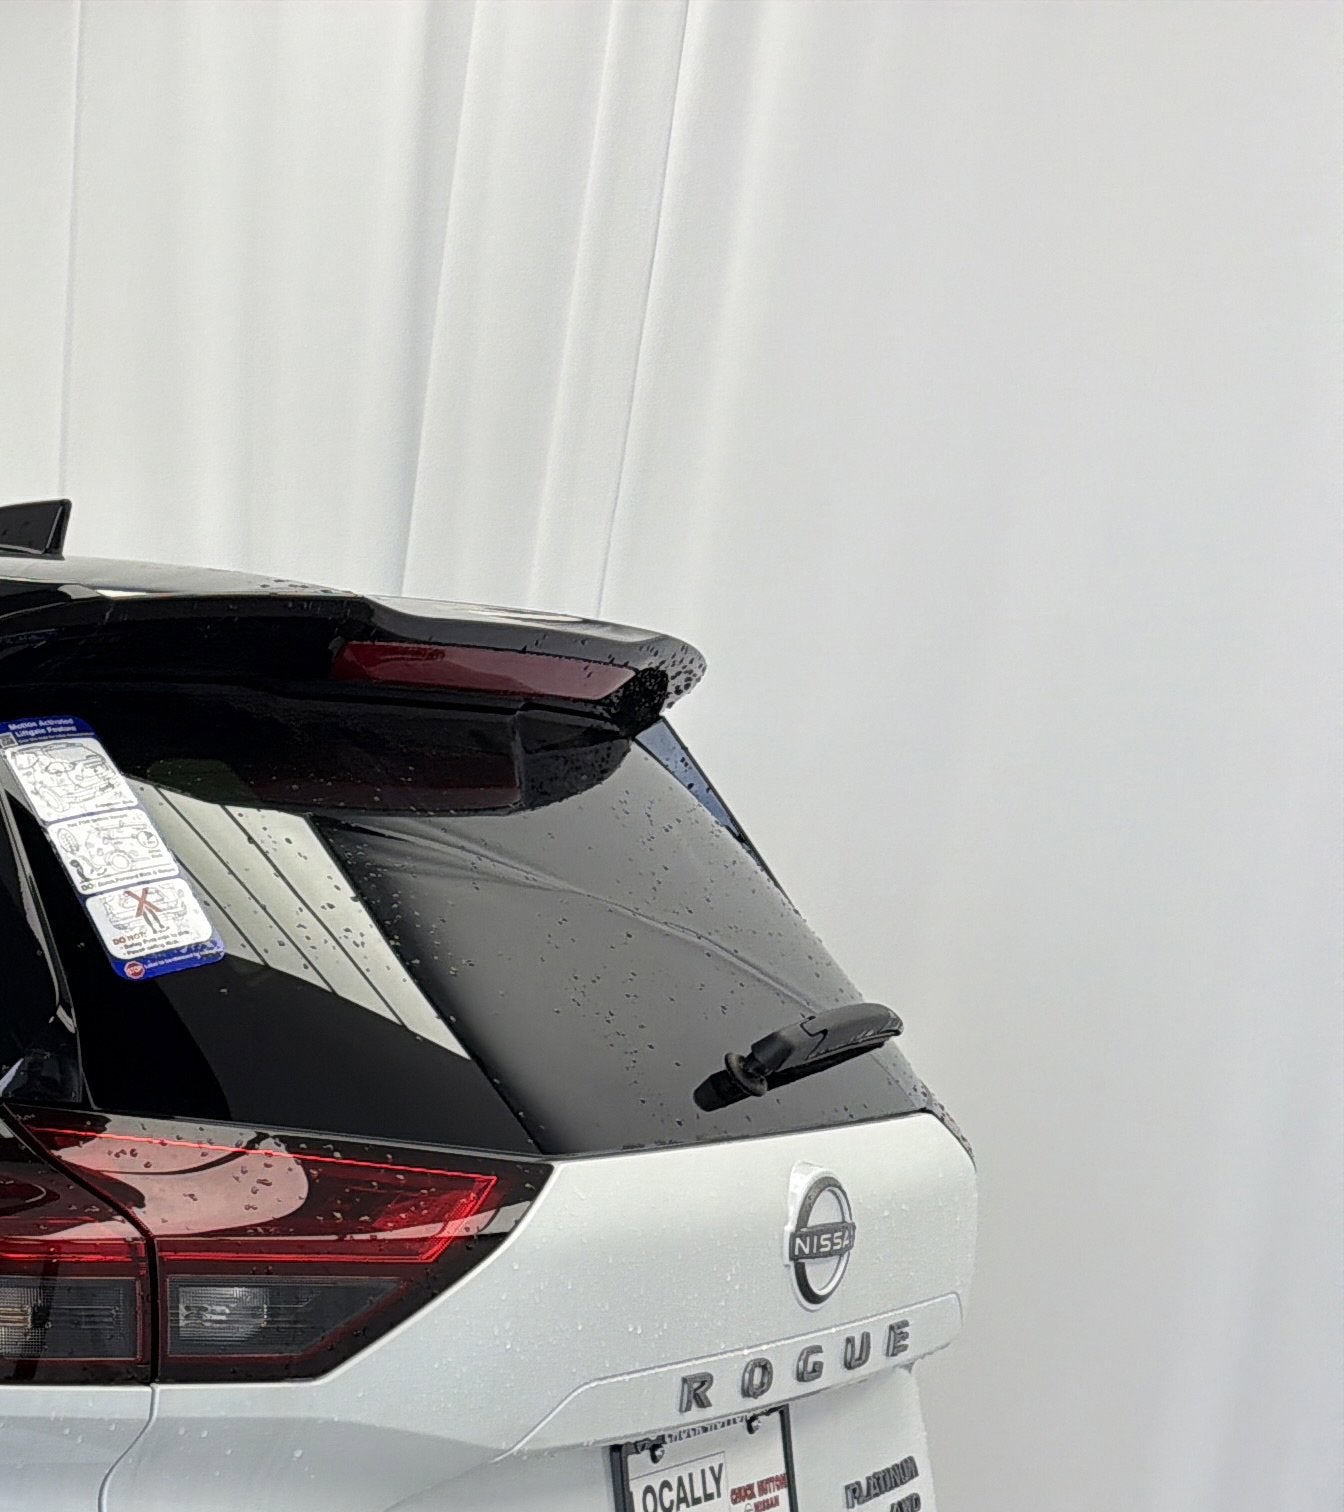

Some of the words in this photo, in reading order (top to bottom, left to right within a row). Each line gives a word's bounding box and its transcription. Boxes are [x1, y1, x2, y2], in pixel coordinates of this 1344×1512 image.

[794, 1230, 852, 1256] NISSA
[679, 1319, 910, 1414] ROGUE
[844, 1455, 920, 1509] PLATINUM
